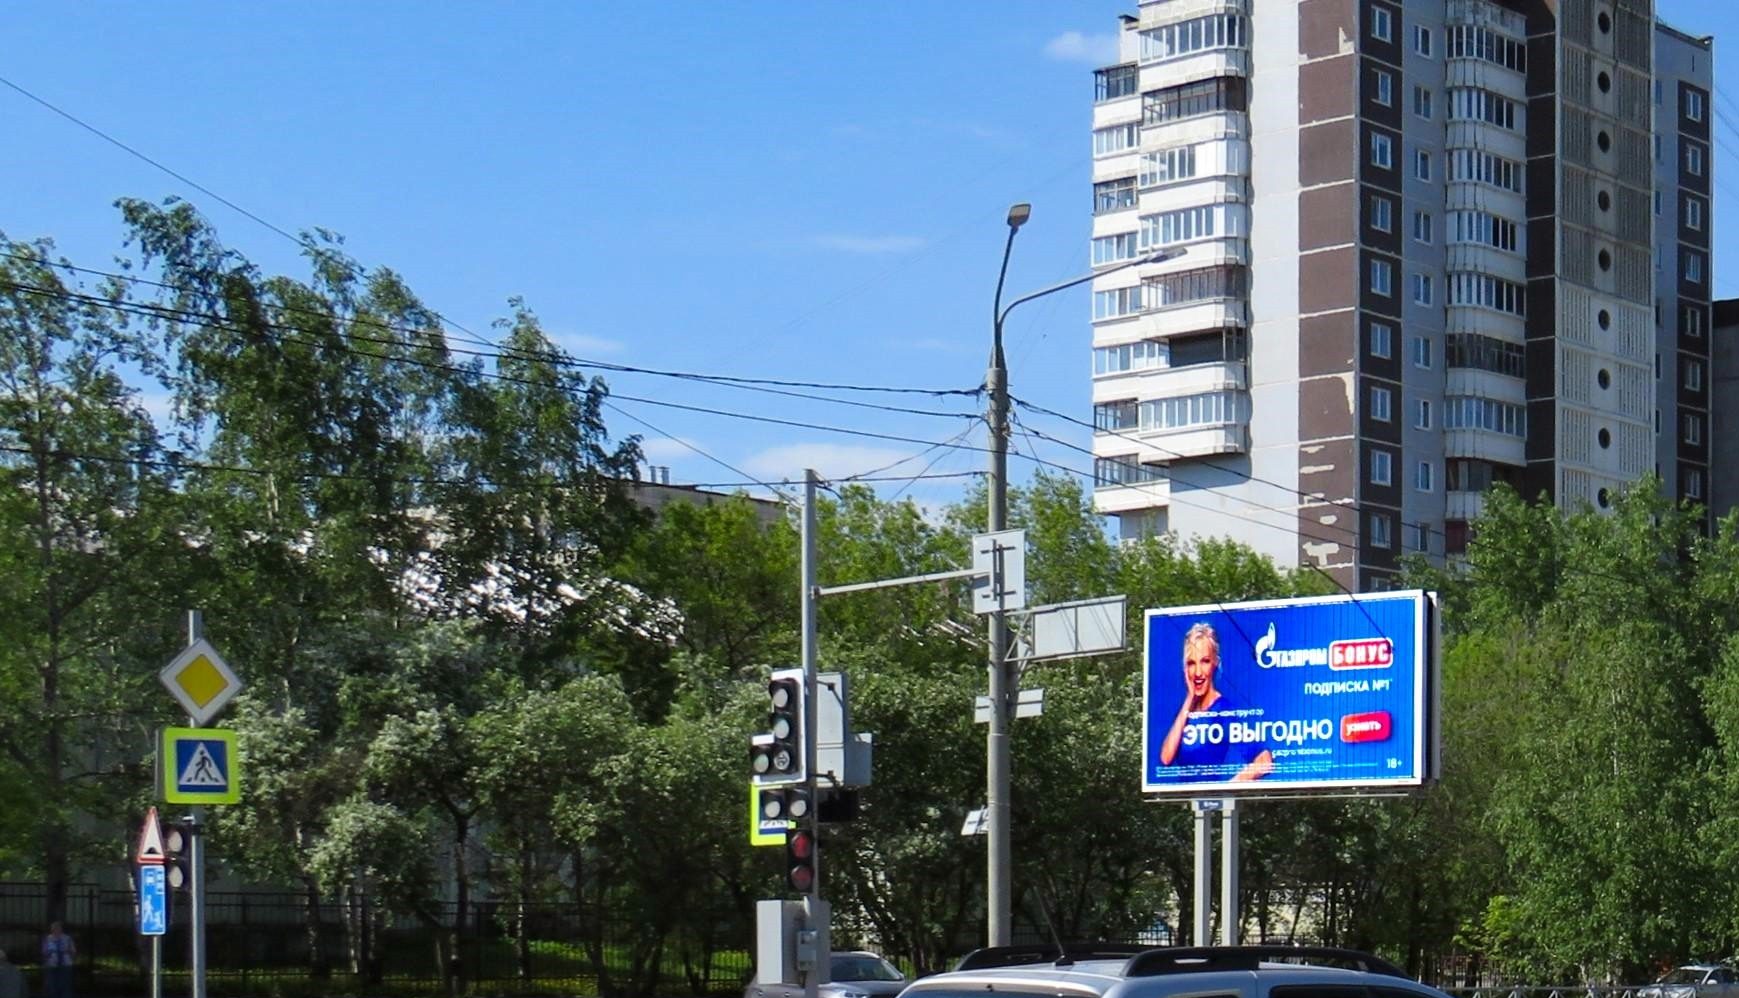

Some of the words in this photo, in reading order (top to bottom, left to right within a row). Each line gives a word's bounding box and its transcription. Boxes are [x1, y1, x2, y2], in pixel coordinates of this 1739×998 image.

[1333, 643, 1389, 665] БОНУС
[1304, 680, 1369, 696] ПОДПИСКА
[1183, 723, 1224, 745] ЭТО
[1229, 718, 1333, 746] ВЫГОДНО
[1386, 757, 1402, 769] 18+
